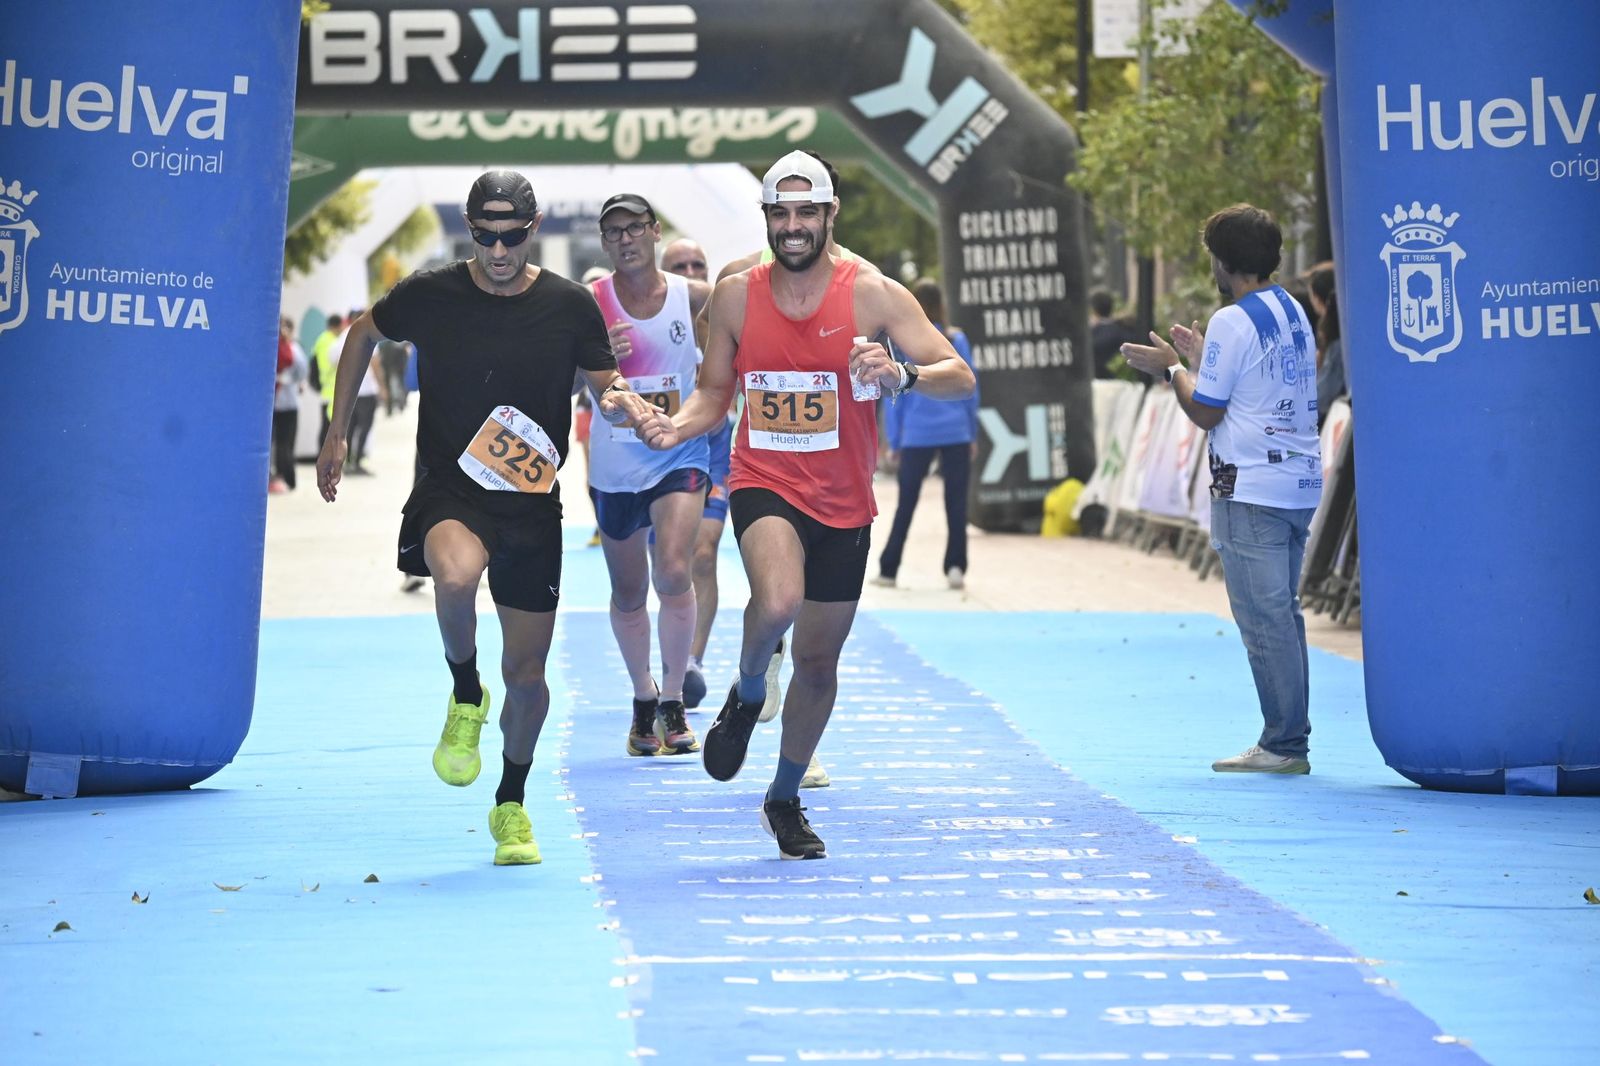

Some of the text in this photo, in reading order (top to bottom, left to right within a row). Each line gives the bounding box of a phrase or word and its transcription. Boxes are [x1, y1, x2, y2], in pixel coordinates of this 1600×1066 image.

[1377, 76, 1600, 150] Huelv
[131, 146, 223, 176] original
[959, 206, 1058, 240] CICLISMO
[963, 237, 1058, 272] TRIATLÓN
[50, 262, 214, 289] Ayuntamiento de
[960, 272, 1066, 306] ATLETISMO
[1481, 277, 1599, 302] Ayuntamien
[46, 289, 210, 330] HUELVA
[984, 306, 1045, 337] TRAIL
[662, 376, 677, 387] 2K
[750, 373, 769, 386] 2K
[813, 374, 831, 386] 2K
[499, 407, 518, 425] 2K
[761, 392, 823, 421] 515
[771, 433, 810, 445] Huelva
[488, 429, 548, 483] 525
[480, 468, 513, 491] Huelv
